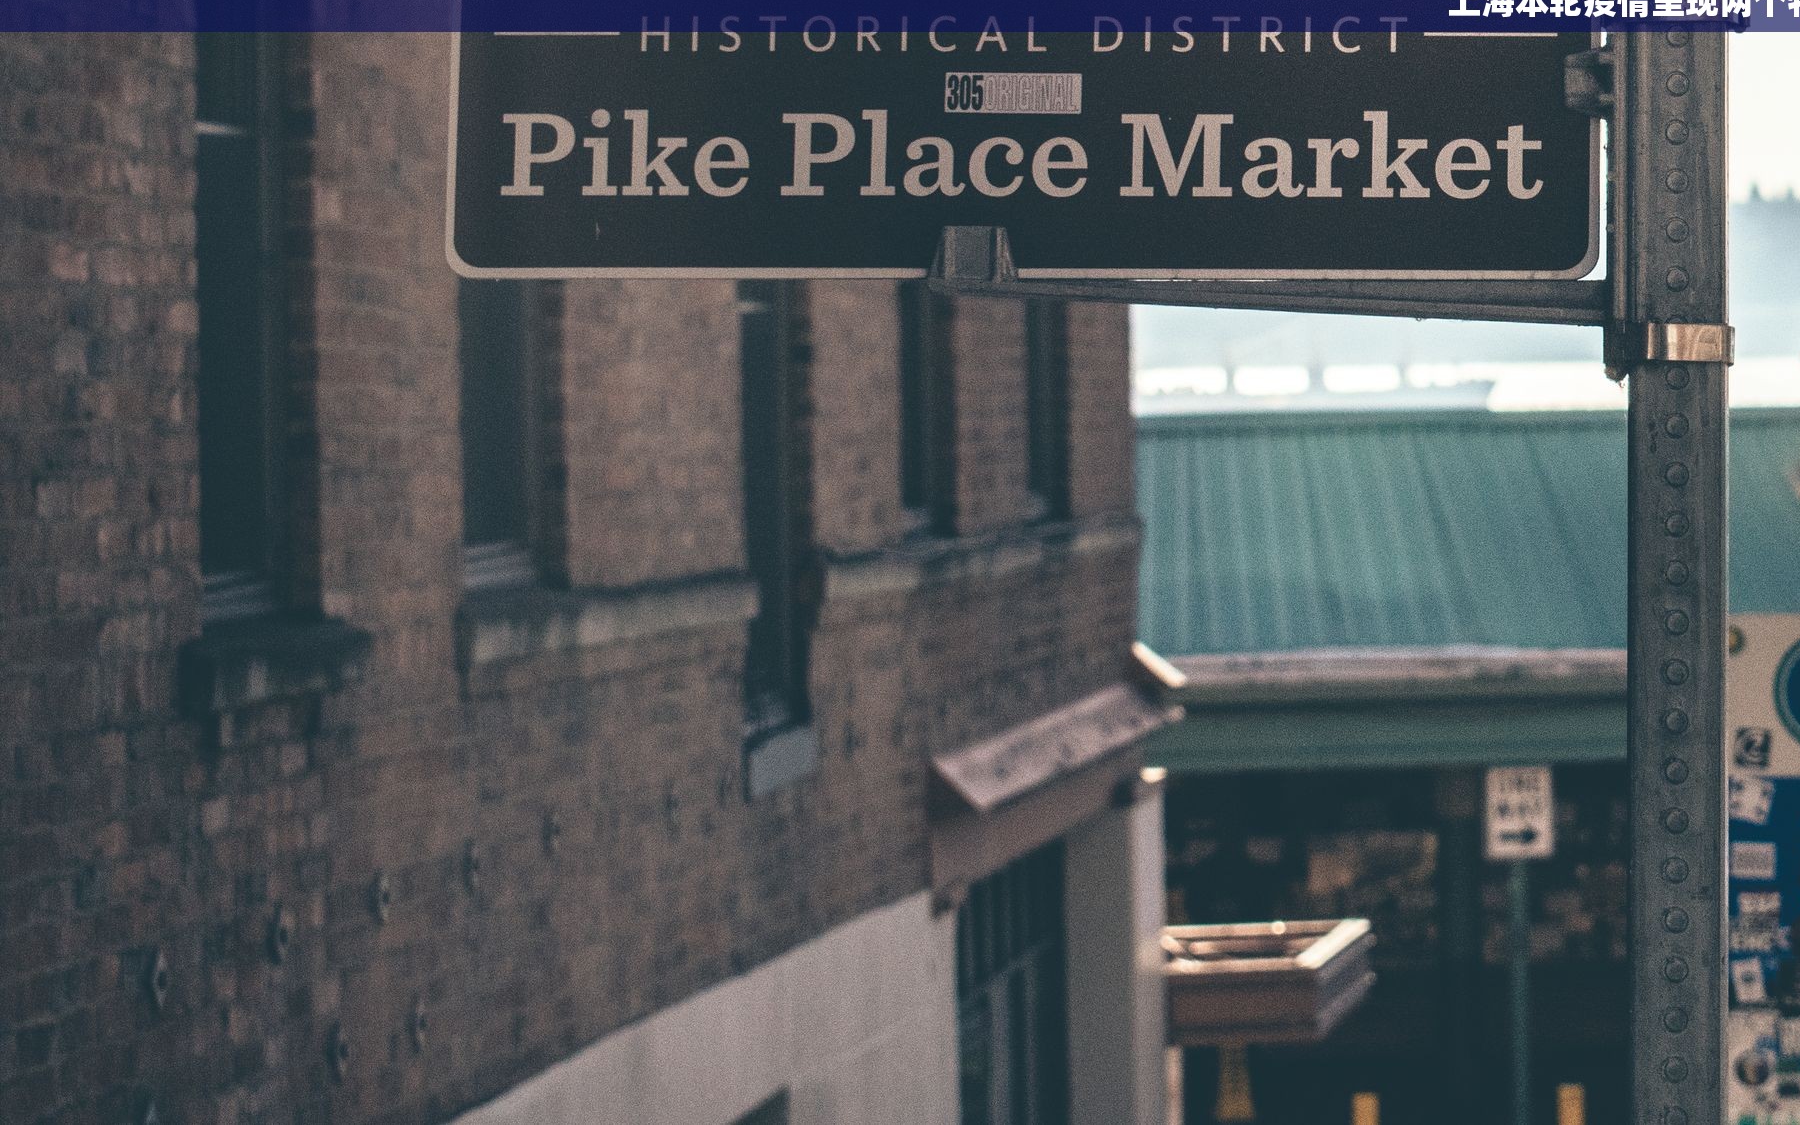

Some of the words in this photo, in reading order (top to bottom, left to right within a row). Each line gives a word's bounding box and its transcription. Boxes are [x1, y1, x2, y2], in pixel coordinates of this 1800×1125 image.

[640, 15, 1047, 52] HISTORICAL
[1093, 15, 1408, 53] DISTRICT
[499, 108, 751, 198] Pike
[780, 109, 1089, 198] Place
[1119, 110, 1545, 200] Market
